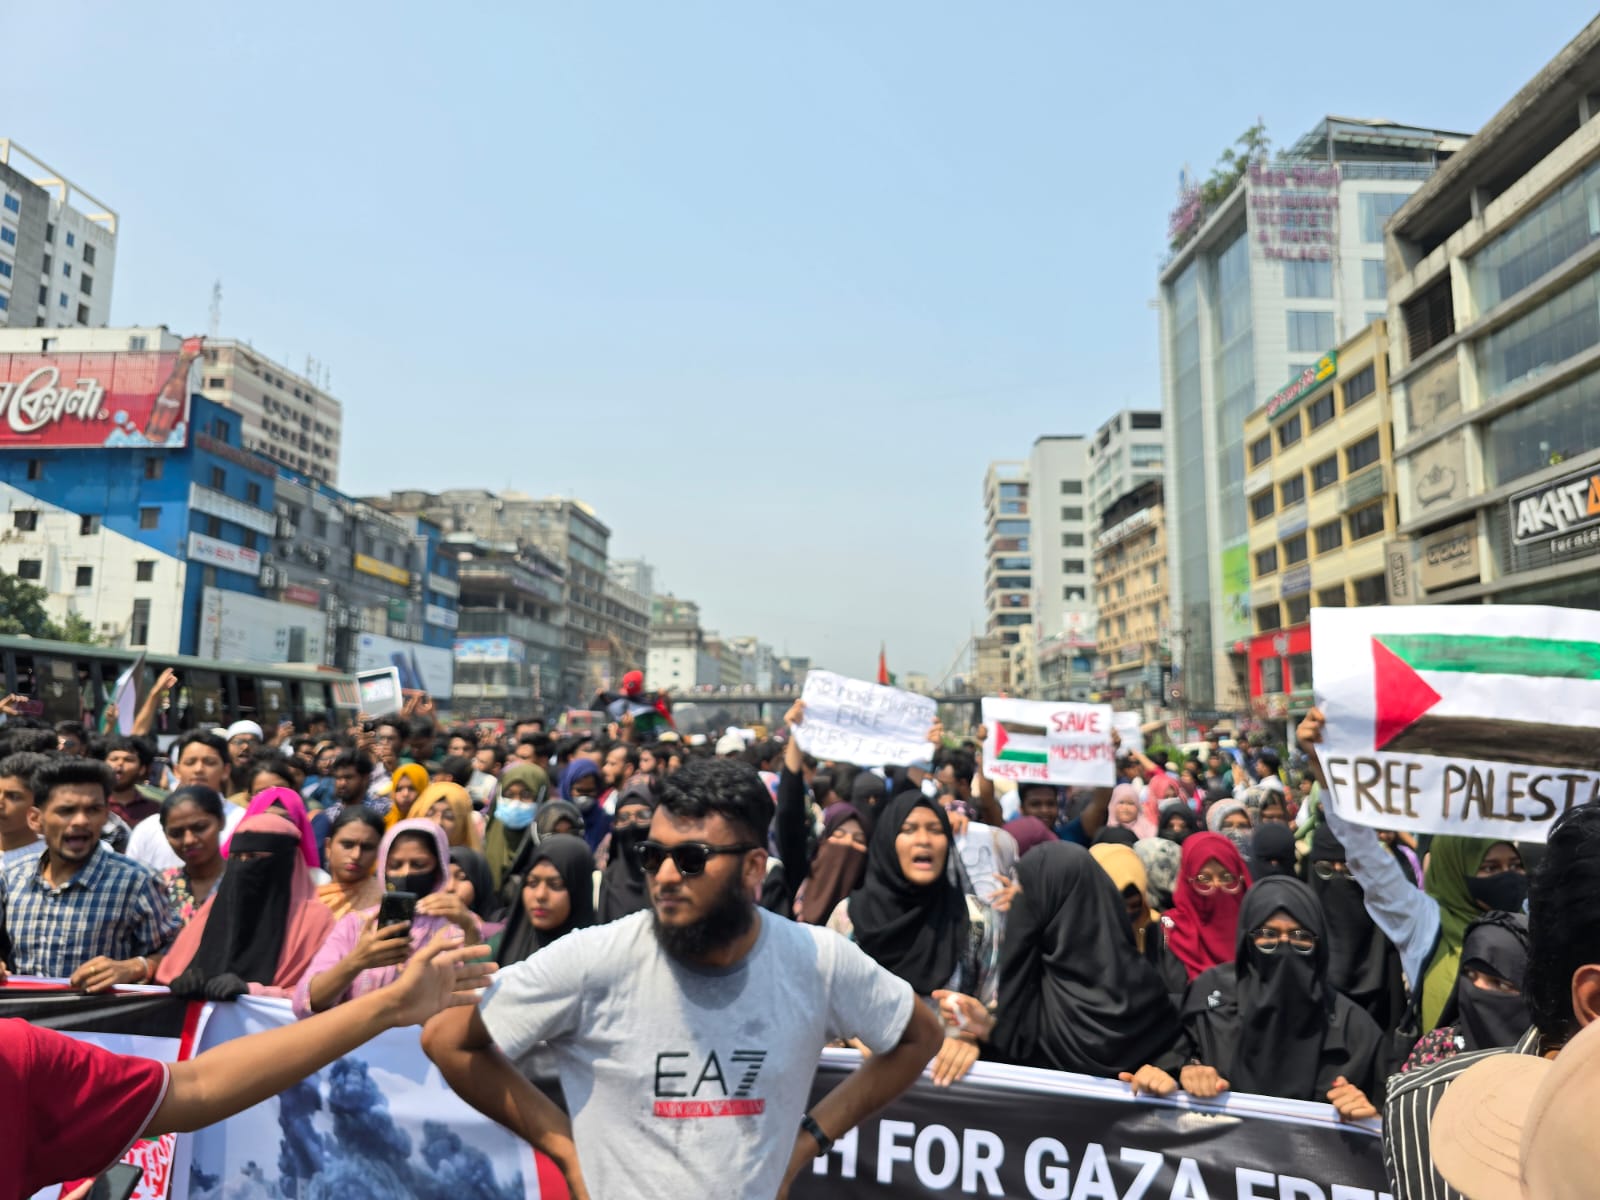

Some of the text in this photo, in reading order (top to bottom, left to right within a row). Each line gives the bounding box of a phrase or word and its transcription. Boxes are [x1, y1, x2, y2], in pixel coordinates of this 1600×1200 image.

[1051, 712, 1101, 733] SAVE
[1328, 758, 1422, 817] FREE
[655, 1050, 767, 1097] EA7
[877, 1119, 1005, 1196] FOR
[1024, 1136, 1212, 1200] GAZA
